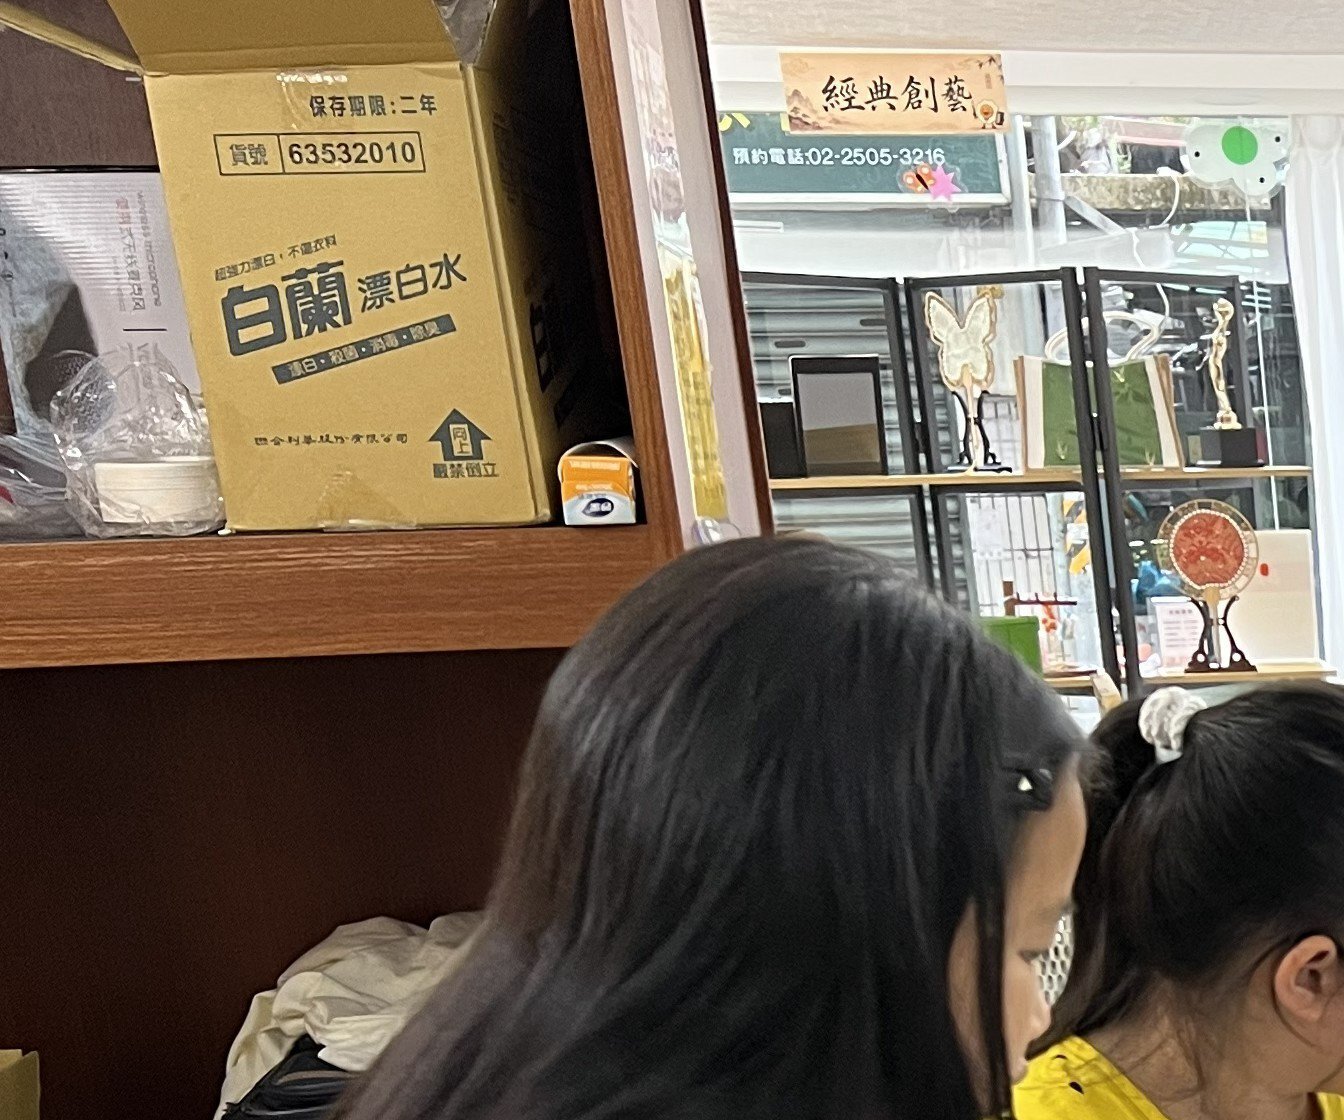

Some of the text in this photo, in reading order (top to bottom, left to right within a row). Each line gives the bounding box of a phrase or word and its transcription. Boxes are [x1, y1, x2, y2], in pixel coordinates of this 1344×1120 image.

[821, 75, 972, 113] 經典創藝
[229, 141, 416, 166] 貨號 63532010
[221, 260, 352, 357] 白蘭
[357, 253, 467, 313] 漂白水
[433, 461, 499, 478] 禁倒立
